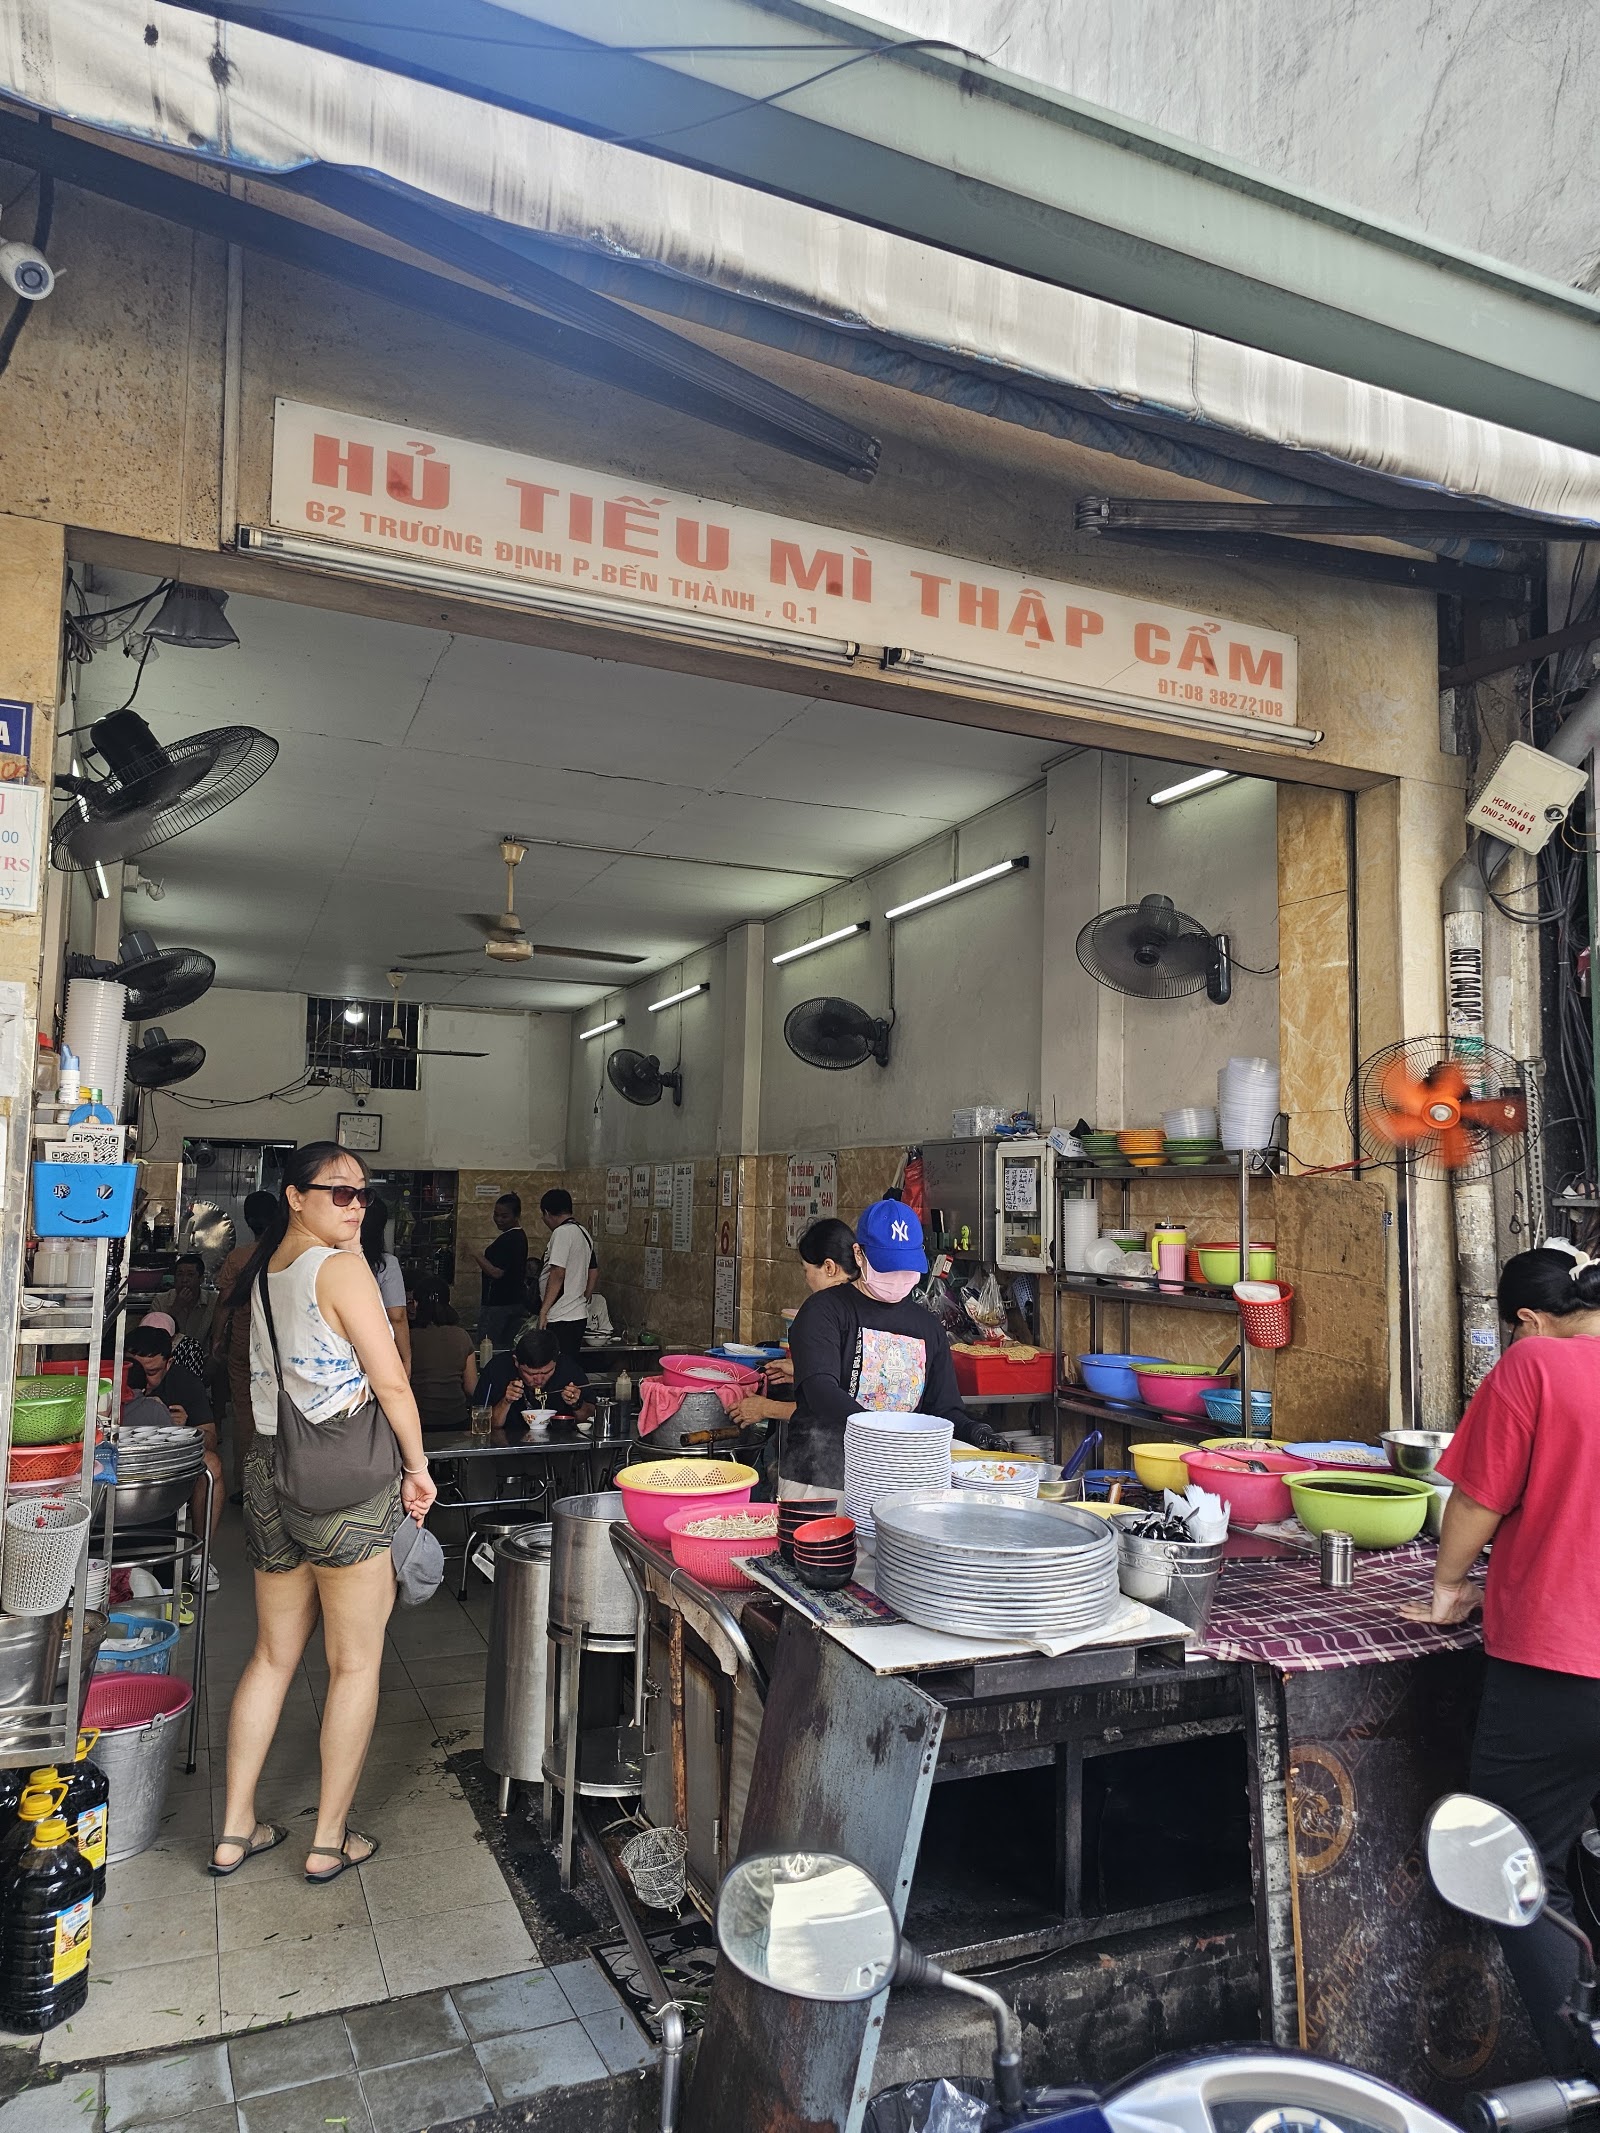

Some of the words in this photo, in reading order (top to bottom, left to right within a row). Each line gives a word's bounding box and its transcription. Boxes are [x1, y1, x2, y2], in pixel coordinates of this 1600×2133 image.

[305, 500, 346, 529] 62
[360, 511, 483, 557] TRƯƠNG
[494, 540, 562, 574] ĐỊNH
[573, 556, 659, 593] P.BẾN
[668, 577, 755, 612] THÀNH
[782, 601, 818, 625] Q.1
[312, 433, 451, 511] HỦ
[506, 478, 730, 572] TIẾU
[769, 538, 873, 604] MÌ
[910, 570, 1105, 650] THẬP
[1134, 621, 1284, 690] CẨM
[1157, 678, 1204, 702] ĐT:08
[1209, 688, 1284, 717] 38272108
[1492, 796, 1537, 823] HCM0466
[0, 857, 31, 873] RS
[720, 1220, 731, 1255] 6
[891, 1219, 910, 1242] NY
